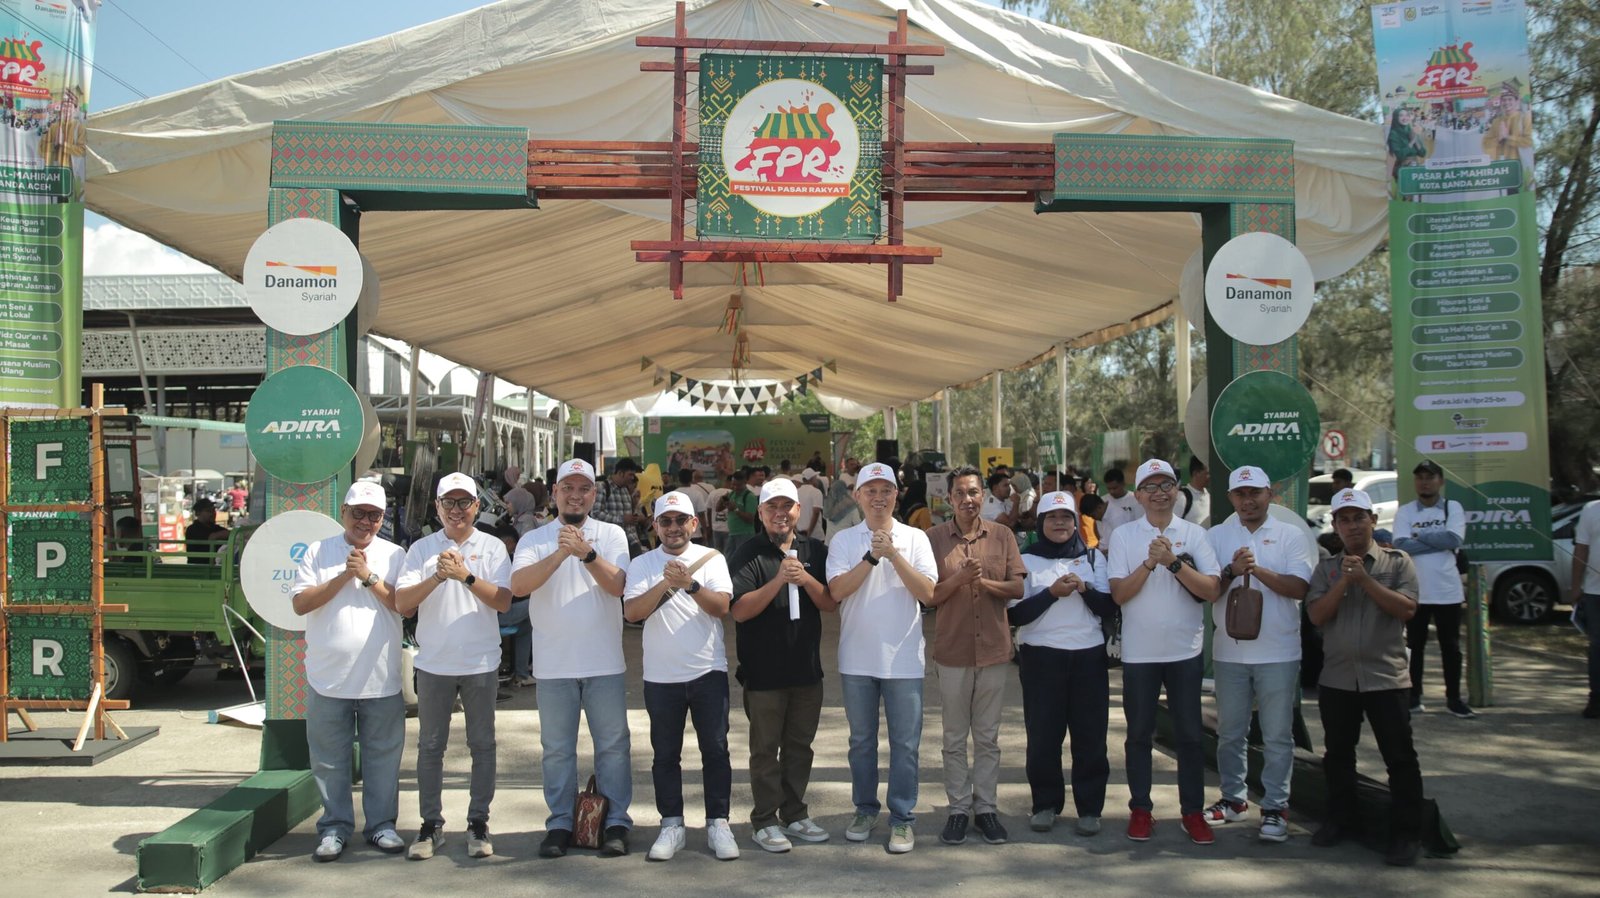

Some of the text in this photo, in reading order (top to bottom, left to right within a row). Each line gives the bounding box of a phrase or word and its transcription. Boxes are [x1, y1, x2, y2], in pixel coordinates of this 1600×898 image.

[1425, 66, 1473, 87] FPR
[750, 144, 830, 177] FPR
[1411, 166, 1510, 181] PASAR AL-MAHIRAH
[28, 183, 52, 191] ACEH
[1420, 177, 1500, 190] KOTA BANDA ACEH
[733, 184, 776, 193] FESTIVAL
[808, 186, 846, 194] RAKYAT
[1453, 213, 1489, 223] Keuangan
[19, 226, 41, 234] Pasar
[12, 245, 38, 254] Inklusi
[1466, 248, 1495, 257] Syariah
[12, 252, 42, 262] Syariah
[265, 274, 338, 289] Danamon
[301, 291, 337, 302] Syariah
[1225, 286, 1293, 301] Danamon
[9, 303, 27, 311] Seni
[1259, 303, 1293, 313] Syariah
[9, 311, 31, 319] Lokal
[5, 340, 31, 349] Masak
[23, 360, 51, 369] Muslim
[1, 367, 24, 377] Ulang
[301, 408, 341, 417] SYARIAH
[1263, 411, 1300, 420] SYARIAH
[261, 419, 341, 434] ADIRA
[1227, 421, 1301, 436] ADIRA
[279, 432, 342, 440] FINANCE
[1243, 434, 1302, 442] FINANCE
[743, 449, 764, 459] FPR
[36, 442, 63, 481] F
[1486, 496, 1531, 505] SYARIAH
[1465, 509, 1531, 524] DIRA
[36, 541, 67, 579] P
[32, 638, 64, 677] R
